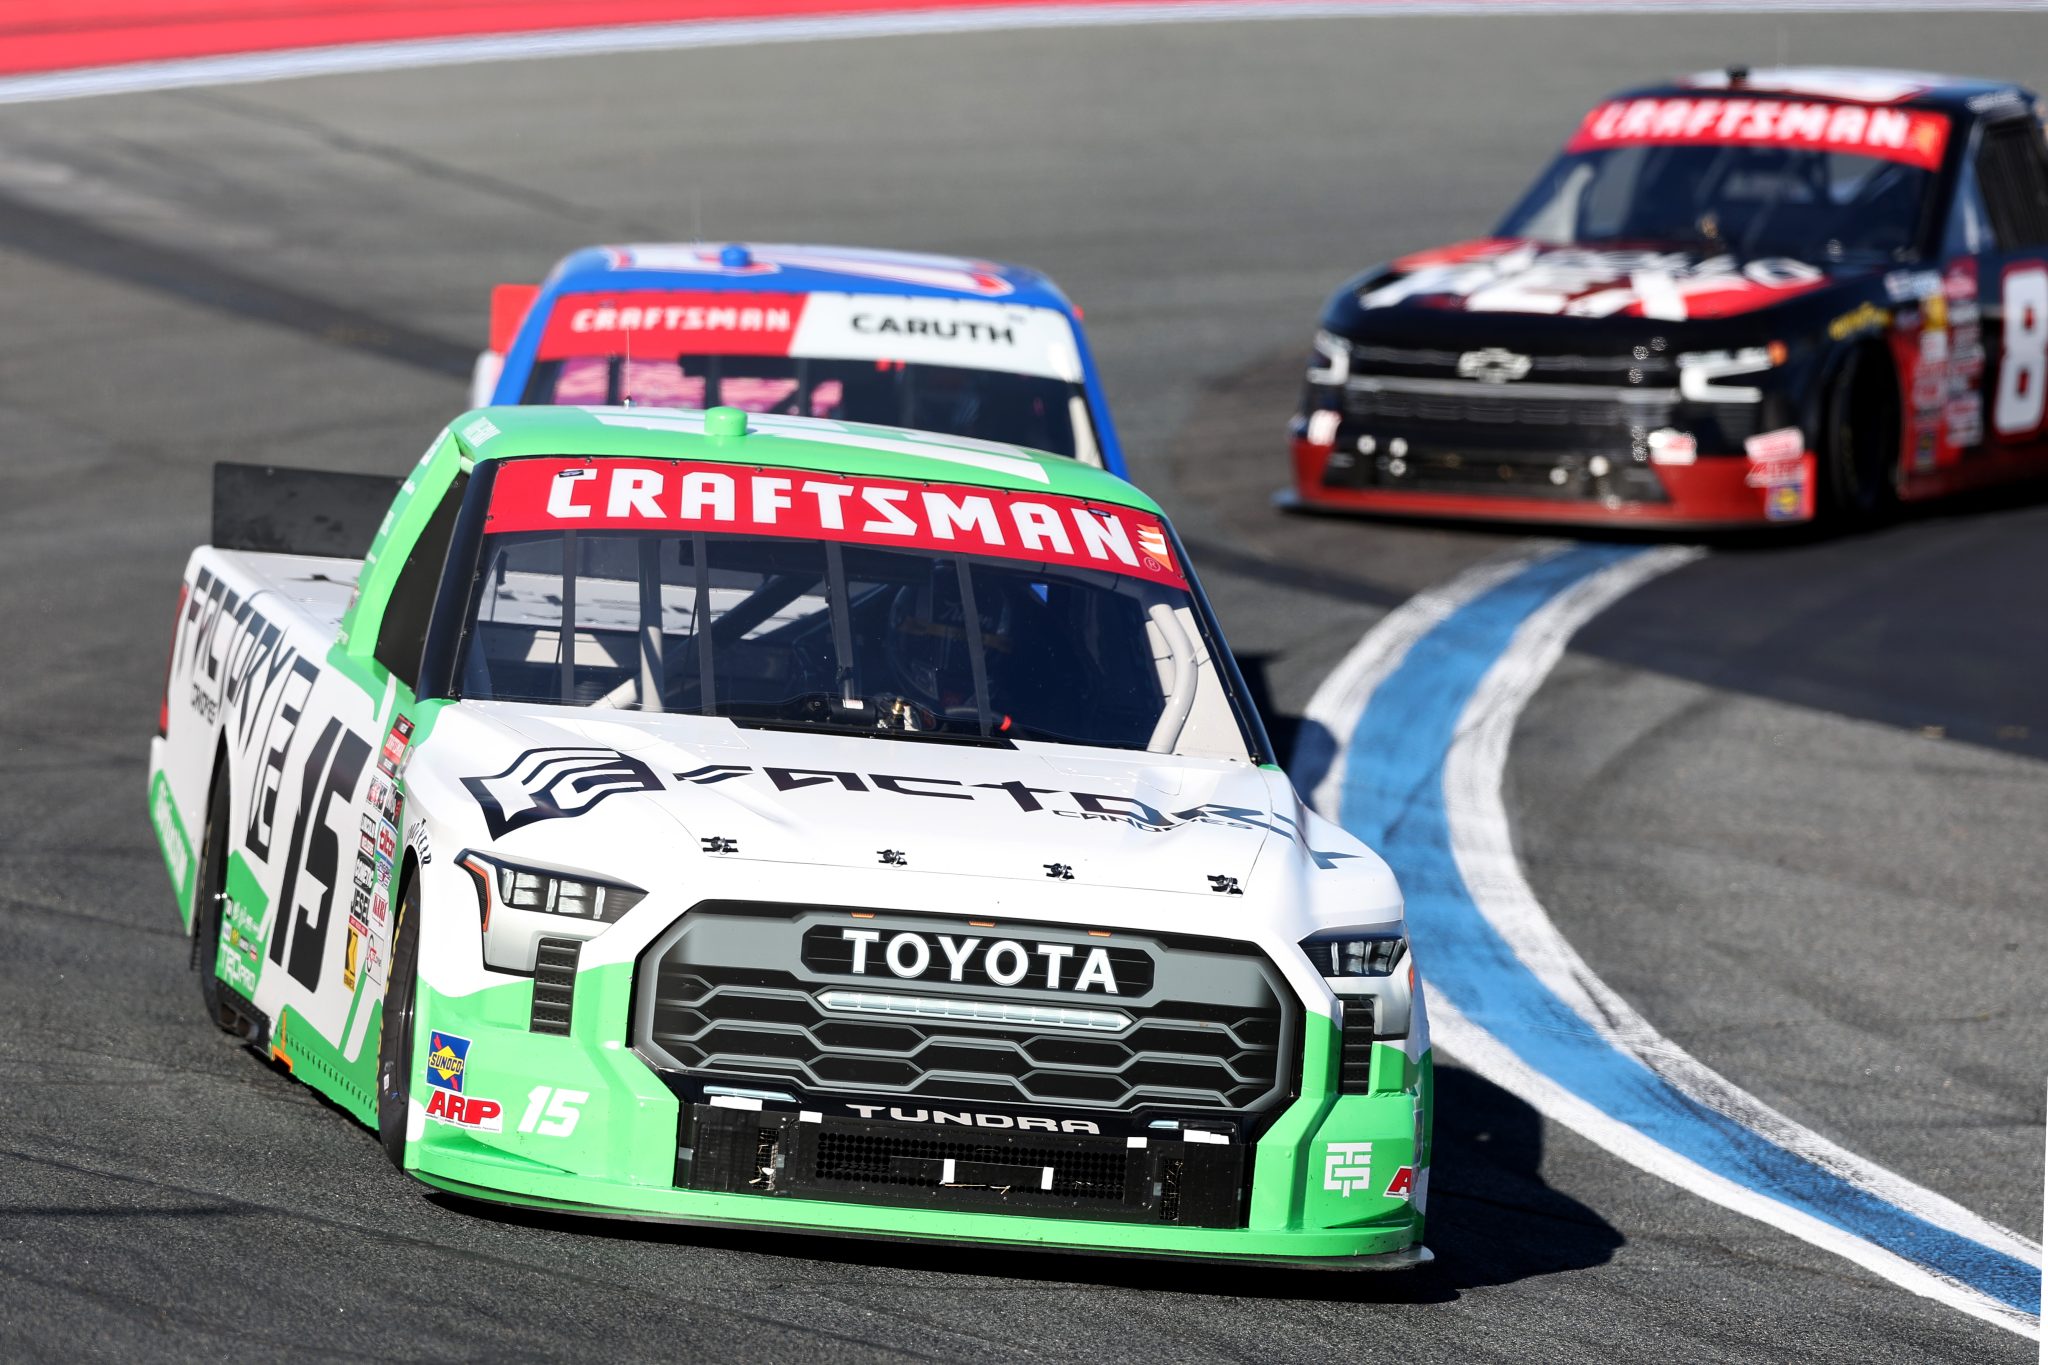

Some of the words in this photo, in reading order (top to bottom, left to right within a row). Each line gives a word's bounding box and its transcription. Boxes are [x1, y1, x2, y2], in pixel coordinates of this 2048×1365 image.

[1590, 98, 1909, 149] CRAFTSMAN
[571, 306, 790, 333] CRAFTSMAN
[851, 312, 1015, 345] CARUTH
[547, 467, 1140, 567] CRAFTSMAN
[269, 715, 373, 994] 15
[842, 929, 1119, 994] TOYOTA
[430, 1053, 464, 1074] SUNOCO
[426, 1089, 501, 1125] ARP
[517, 1085, 590, 1138] 15
[846, 1103, 1101, 1135] TUNDRA
